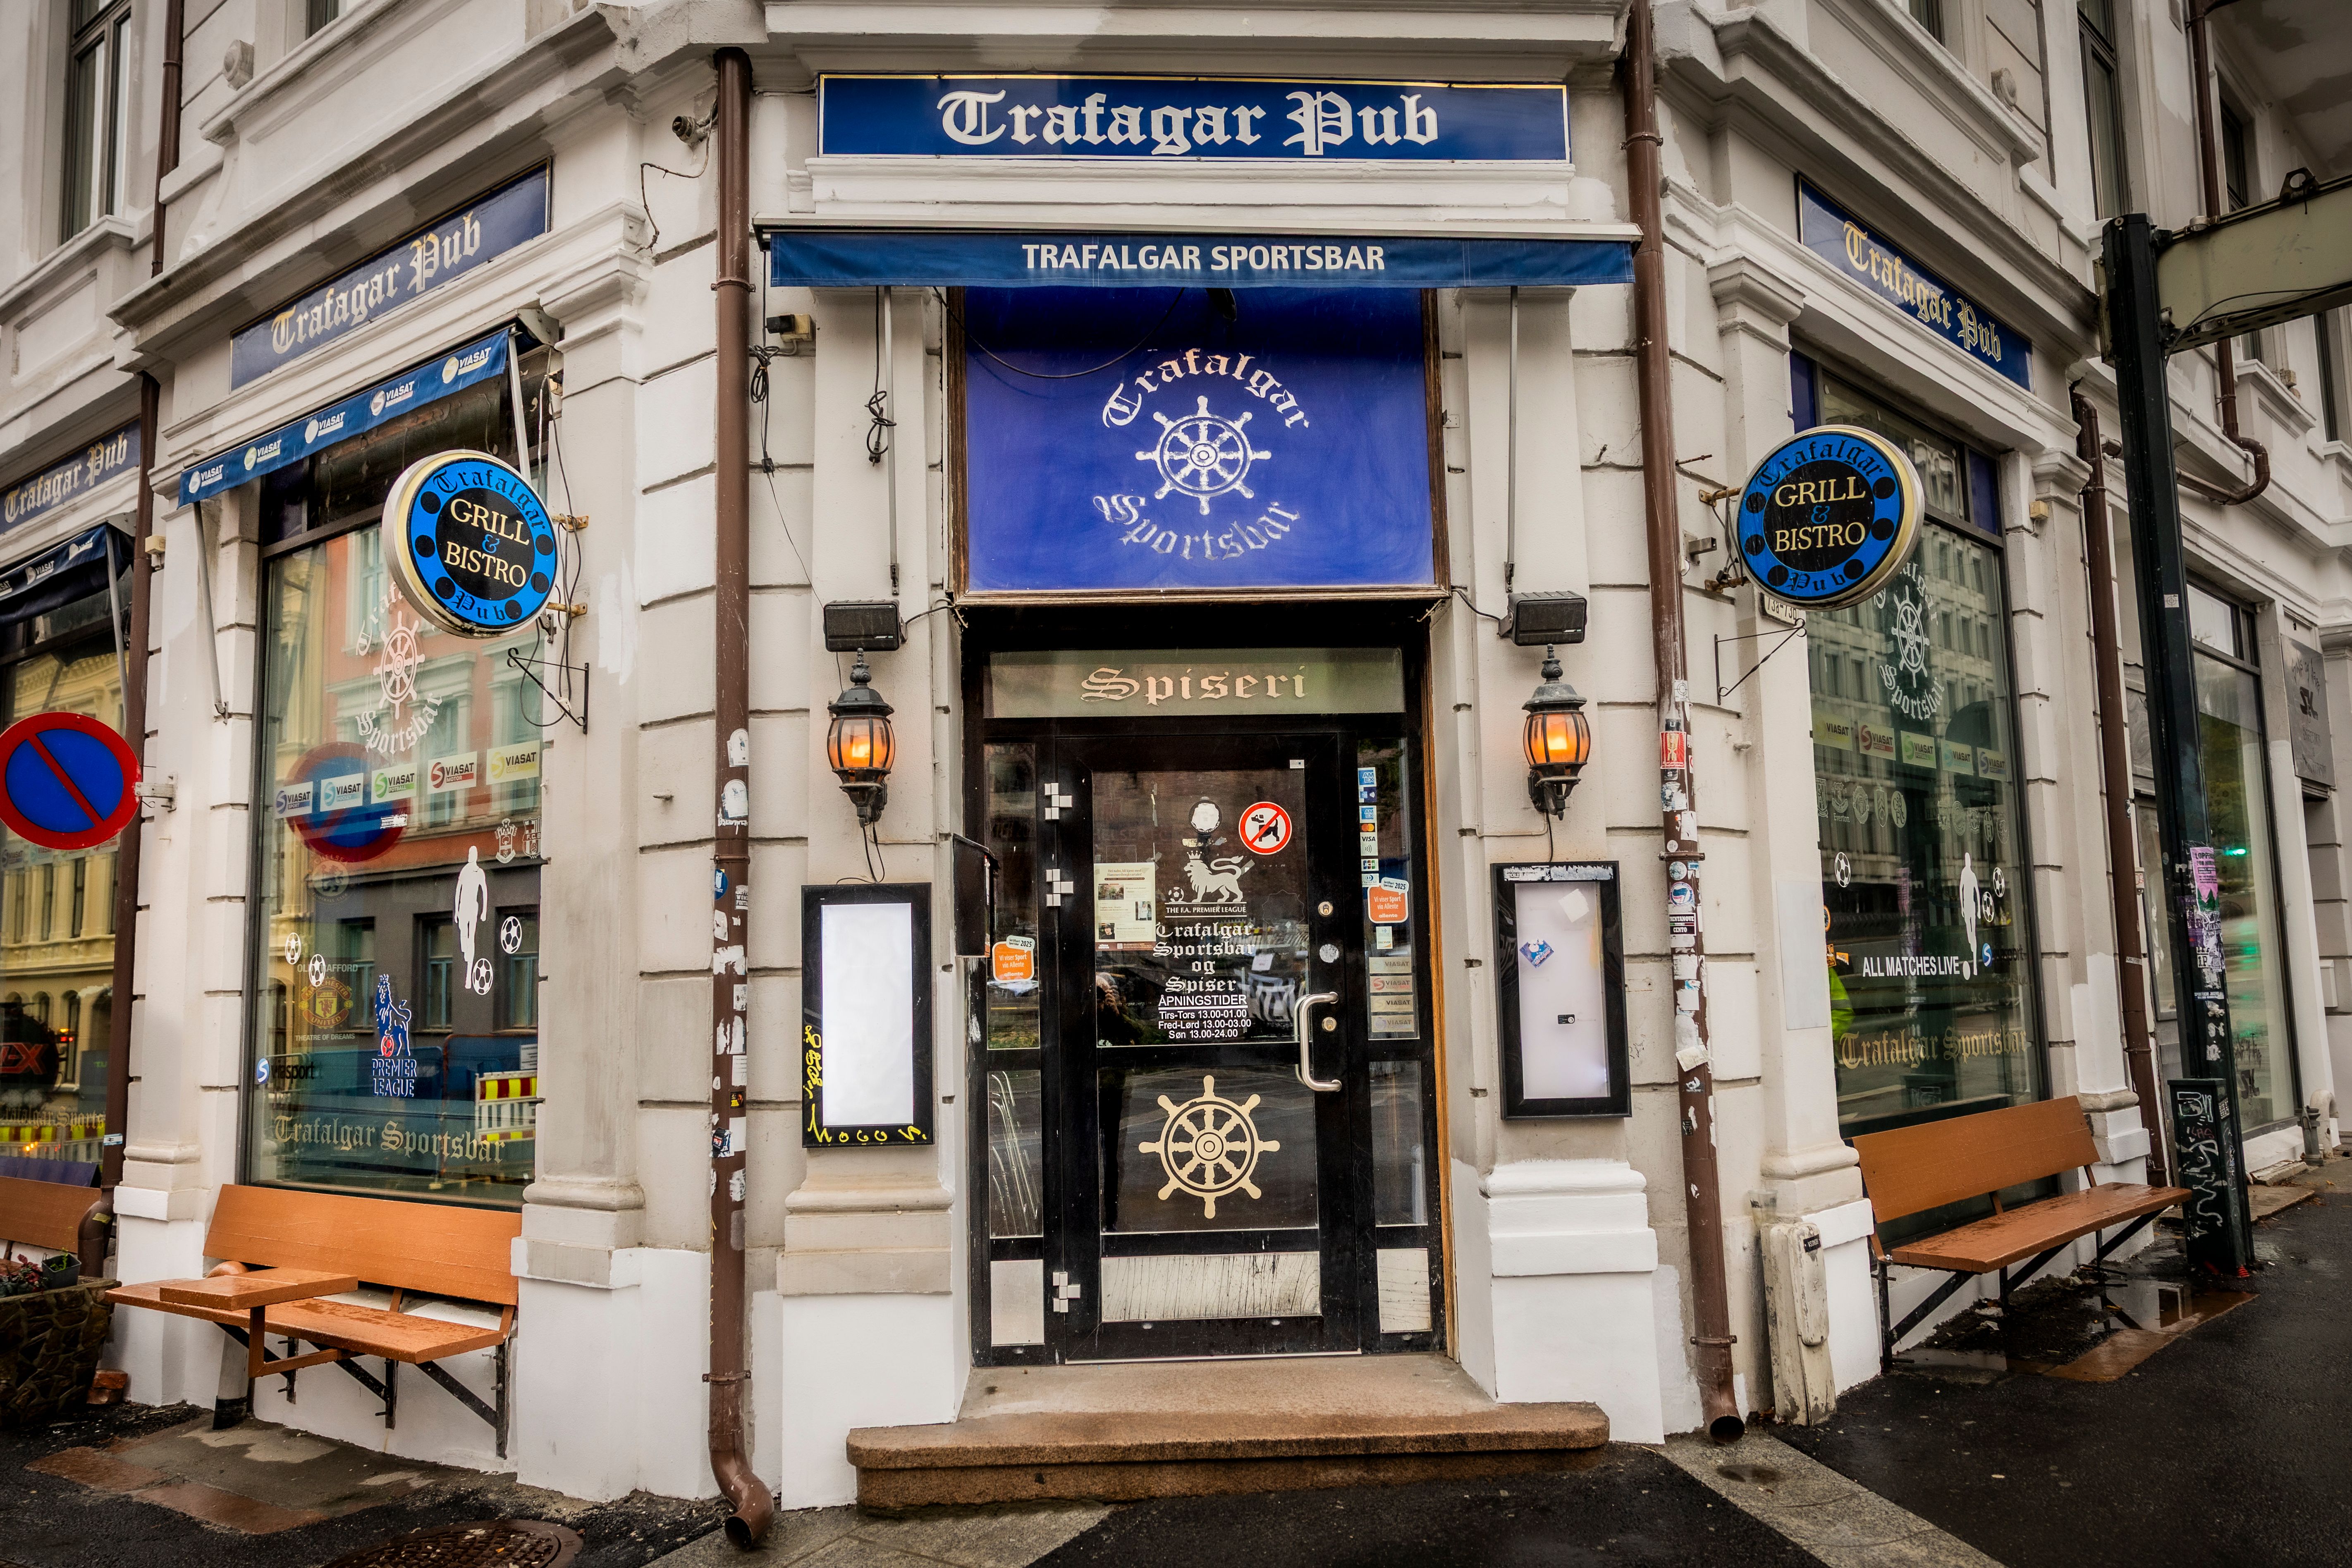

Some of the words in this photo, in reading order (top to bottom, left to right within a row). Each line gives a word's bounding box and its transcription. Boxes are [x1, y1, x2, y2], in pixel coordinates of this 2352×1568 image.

[937, 88, 1265, 156] Trafagar
[1283, 89, 1439, 156] Pub
[1022, 244, 1201, 271] TRAFALGAR
[1210, 245, 1384, 273] SPORTSBAR
[271, 263, 401, 354] Trafagar
[407, 210, 481, 293] Pub
[1843, 221, 1952, 329] Trafagar
[1957, 298, 2001, 362] Pub
[459, 347, 492, 368] VIASAT
[385, 380, 414, 400] VIASAT
[1102, 347, 1310, 428] Trafalgar
[318, 411, 346, 430] VIASAT
[257, 439, 282, 457] VIASAT
[201, 464, 224, 481] VIASAT
[1755, 440, 1884, 487] Trafalgar
[4, 462, 83, 523] Trafagar
[84, 431, 128, 487] Pub
[433, 469, 547, 530] Trafalgar
[1775, 476, 1866, 508] GRILL
[450, 498, 531, 546] GRILL
[1811, 505, 1831, 524] &
[1092, 493, 1301, 562] Sportsbar
[1775, 521, 1866, 552] BISTRO
[482, 533, 500, 554] &
[35, 560, 55, 576] VIASAT
[444, 541, 526, 588] BISTRO
[0, 580, 11, 592] SAT
[1784, 572, 1846, 592] Pub
[451, 590, 507, 621] Pub
[1080, 666, 1308, 707] Spiseri
[1879, 664, 1946, 720] Sportsbar
[355, 692, 443, 755] Sportsbar
[1826, 722, 1849, 737] VIASAT
[1872, 732, 1893, 746] VIASAT
[1914, 742, 1934, 755] VIASAT
[506, 752, 537, 766] VIASAT
[1953, 751, 1971, 762] VIASAT
[1989, 757, 2005, 769] VIASAT
[445, 762, 474, 776] VIASAT
[336, 783, 361, 795] VIASAT
[388, 773, 415, 786] VIASAT
[288, 791, 311, 803] VIASAT
[1833, 813, 1850, 823] Everton
[1155, 922, 1252, 939] Trafalgar
[1152, 941, 1255, 958] Sportsbar
[1191, 960, 1216, 975] og
[1862, 956, 1885, 977] ALL
[1886, 956, 1937, 976] MATCHES
[1939, 956, 1960, 975] LIVE
[305, 980, 348, 997] MACHESTER
[1165, 975, 1237, 994] Spiser
[1158, 994, 1247, 1006] ÅPNINGSTIDER
[311, 1016, 342, 1026] UNITED
[1159, 1011, 1195, 1020] Tirs-Tors
[1198, 1009, 1247, 1019] 13.00-01.00
[1158, 1020, 1200, 1030] Fred-Lørd
[1202, 1019, 1252, 1028] 13.00-03.00
[1169, 1030, 1186, 1039] Søn
[1190, 1028, 1238, 1038] 13.00-24.00
[1840, 1030, 1938, 1069] Trafalgar
[1943, 1024, 2027, 1064] Sportsbar
[371, 1058, 418, 1078] PREMIER
[373, 1078, 415, 1098] LEAGUE
[5, 1105, 54, 1130] rafalgar
[274, 1114, 377, 1151] Trafalgar
[381, 1119, 506, 1165] Sportsbar
